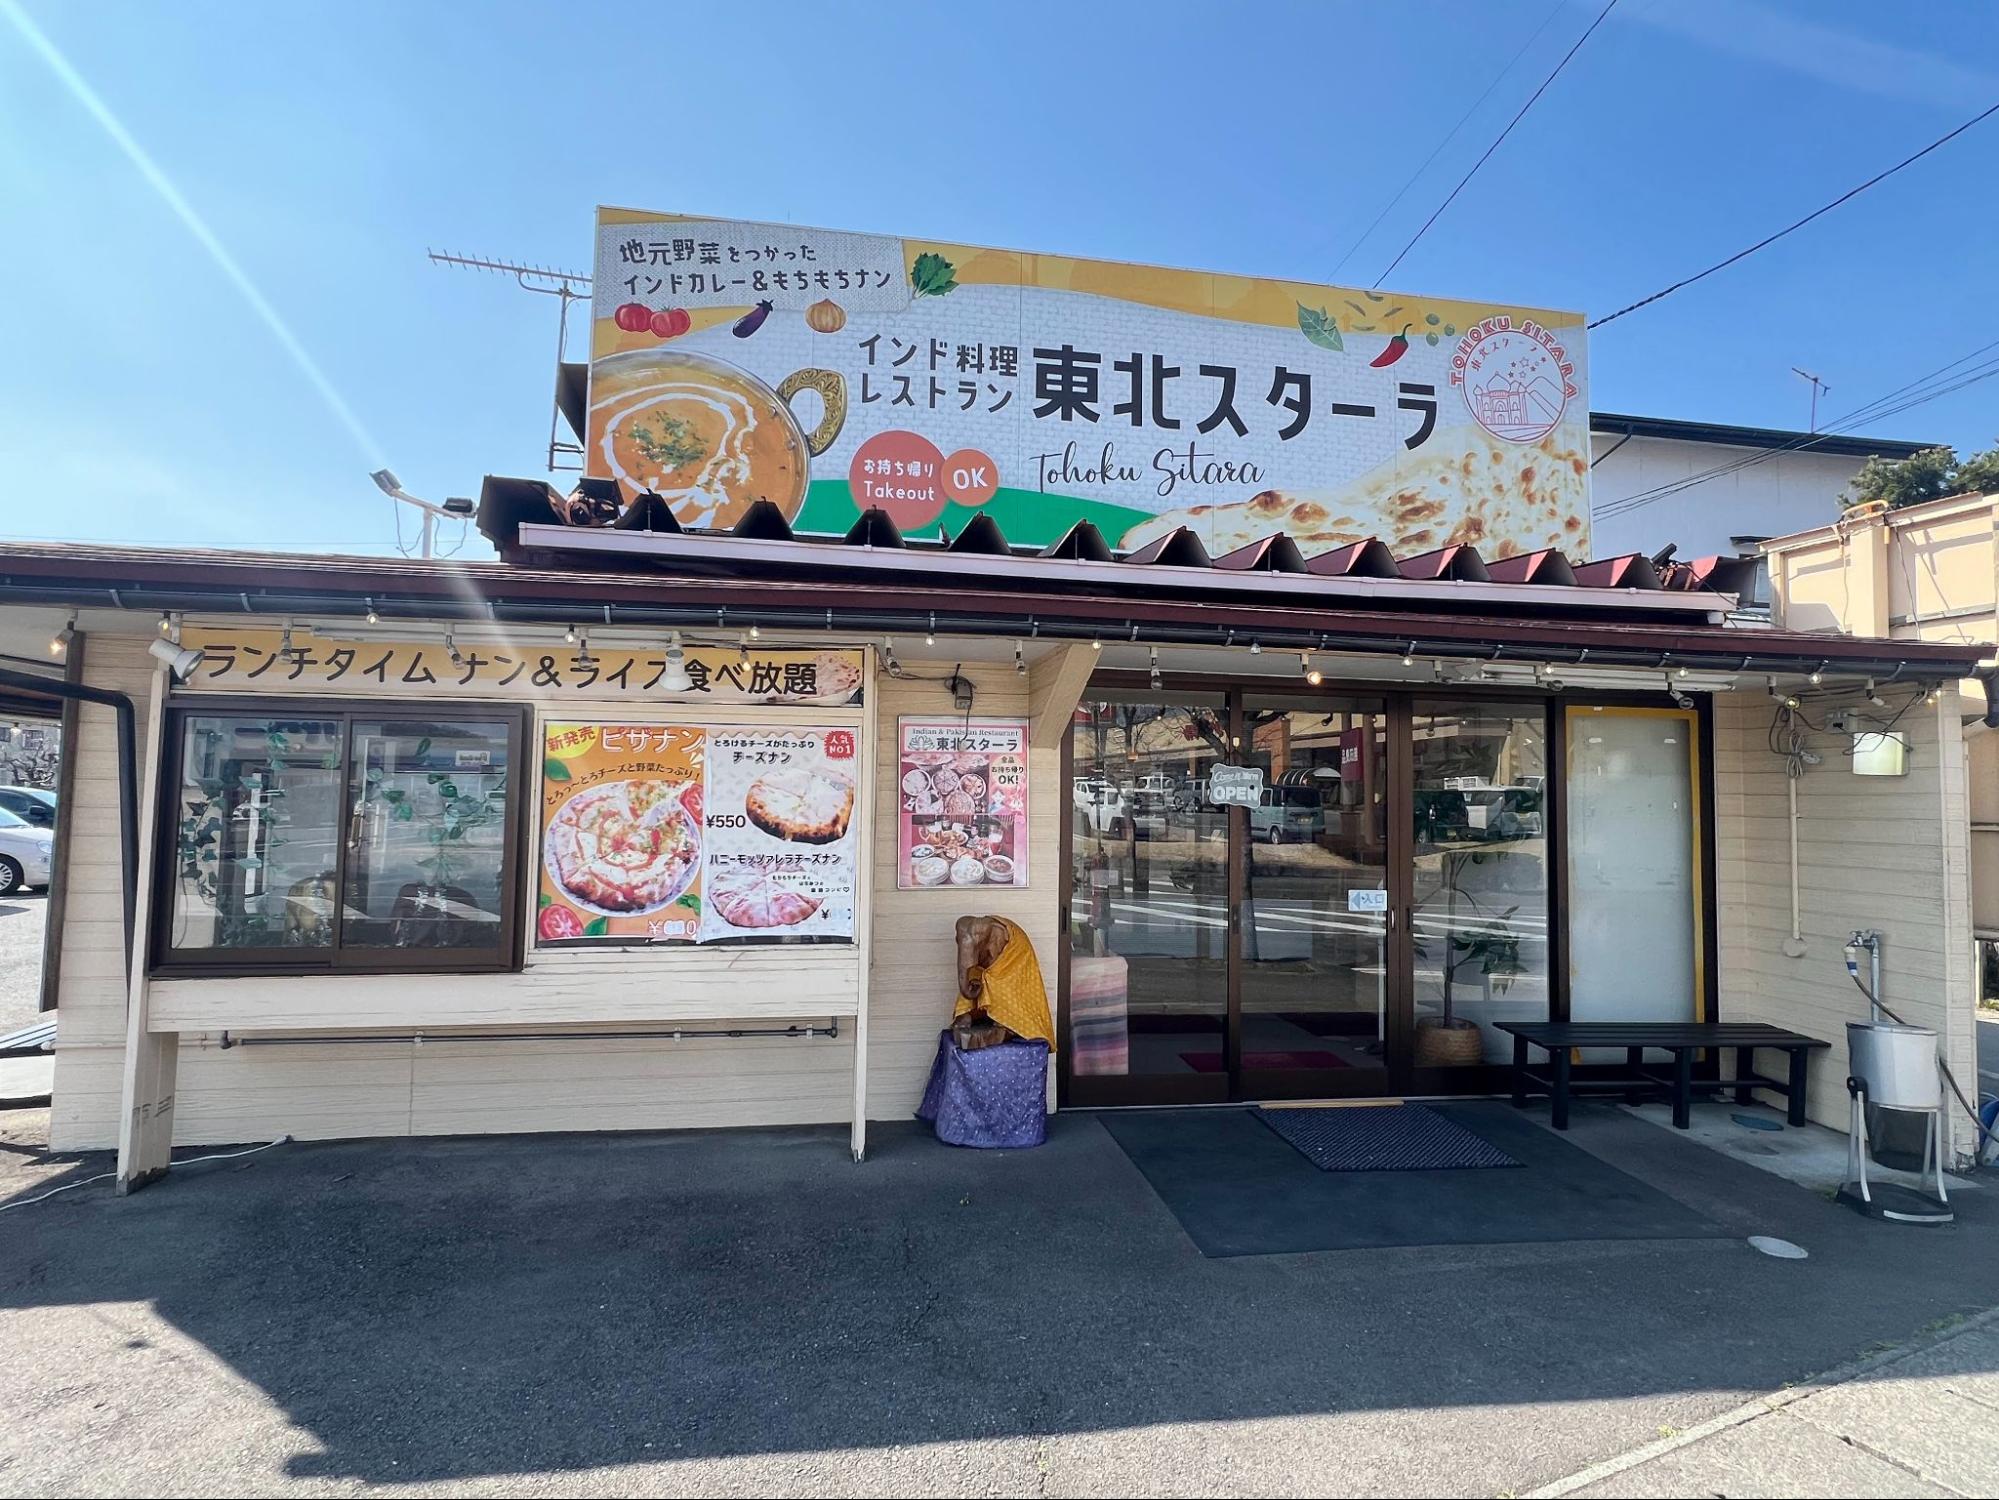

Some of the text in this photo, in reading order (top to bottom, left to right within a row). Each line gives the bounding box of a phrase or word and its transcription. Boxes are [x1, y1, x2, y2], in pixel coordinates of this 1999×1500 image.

[620, 239, 817, 266] 地元野菜をつかった
[624, 269, 891, 295] インドカレー&もちもちナン
[859, 334, 1018, 377] インド料理
[1451, 317, 1577, 398] TOHOKU SITARA
[861, 373, 1012, 413] レストラン
[1032, 345, 1438, 451] 東北スターラ
[863, 458, 934, 478] お持ち帰り
[953, 466, 988, 490] OK
[1029, 441, 1265, 497] Tohoku Sitara
[863, 481, 935, 501] Takeout
[203, 645, 437, 683] ランチタイム
[547, 725, 596, 752] 新発売
[602, 727, 705, 754] ピザナン
[831, 733, 849, 744] 人気
[733, 751, 792, 764] チーズナン
[998, 775, 1019, 785] OK!
[1213, 785, 1259, 801] OPEN
[706, 814, 746, 829] ¥550
